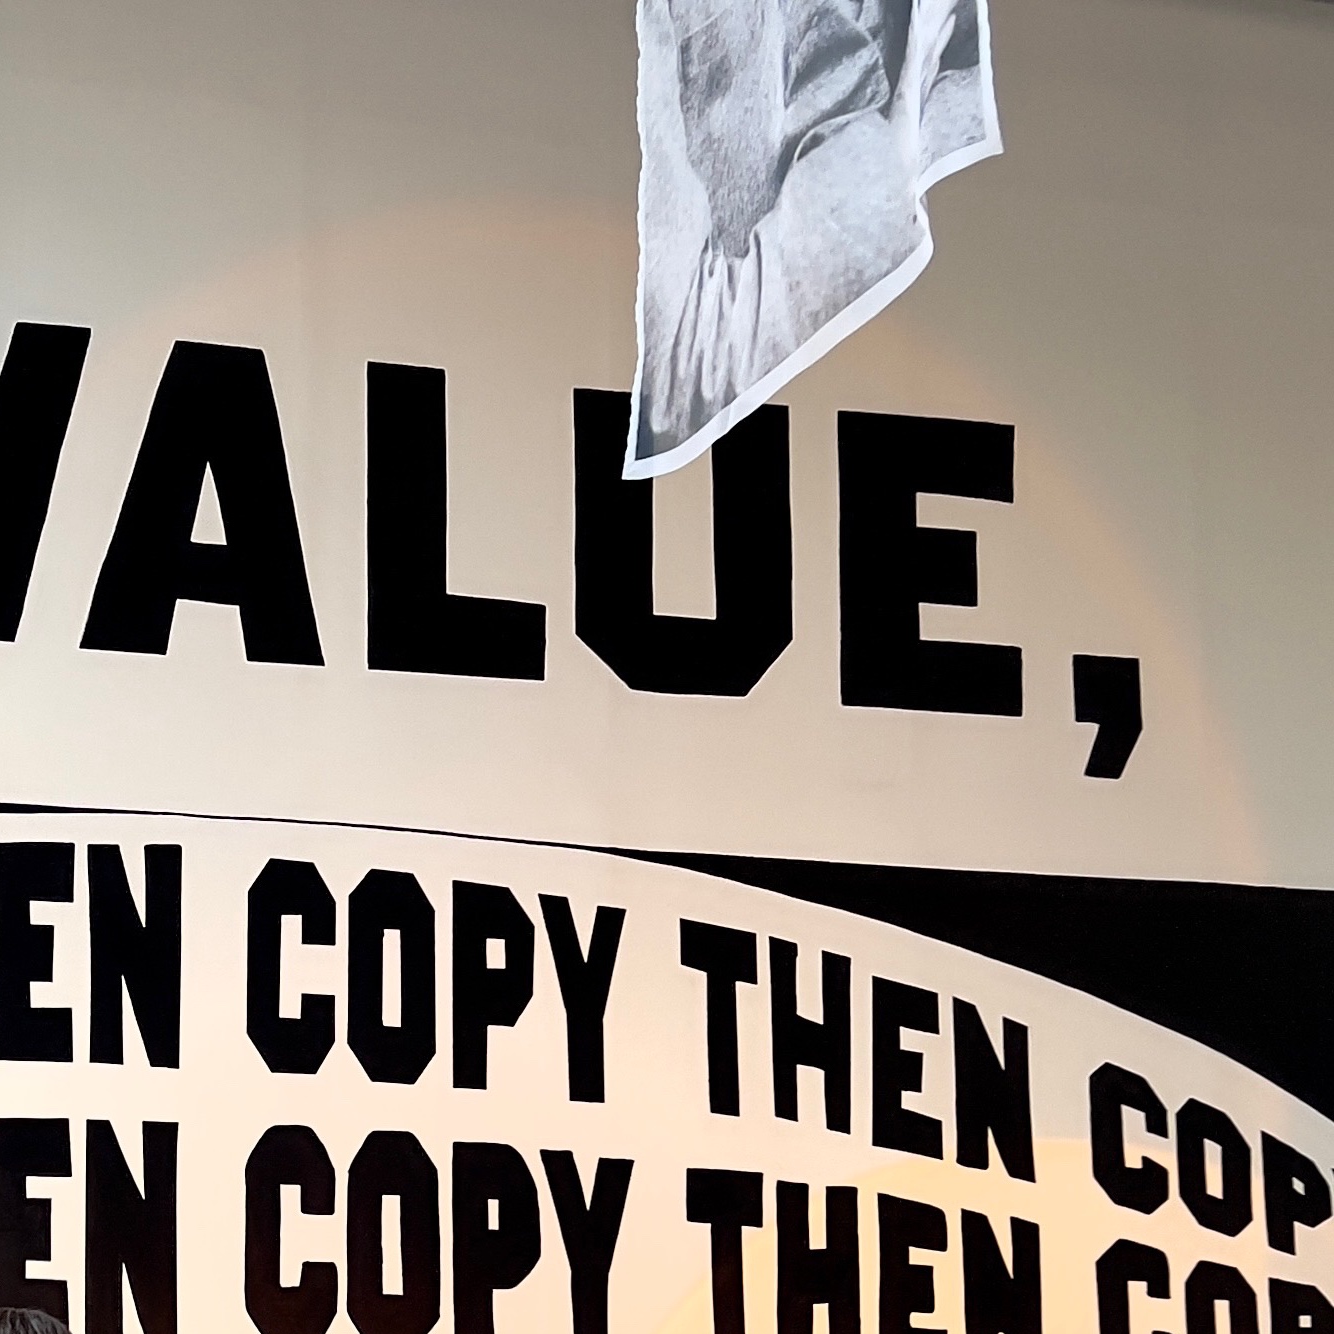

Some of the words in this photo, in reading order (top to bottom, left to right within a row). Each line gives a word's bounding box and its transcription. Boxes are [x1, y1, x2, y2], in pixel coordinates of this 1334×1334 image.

[247, 858, 627, 1103] COPY
[680, 917, 1035, 1183] THEN
[1090, 1062, 1334, 1255] COP
